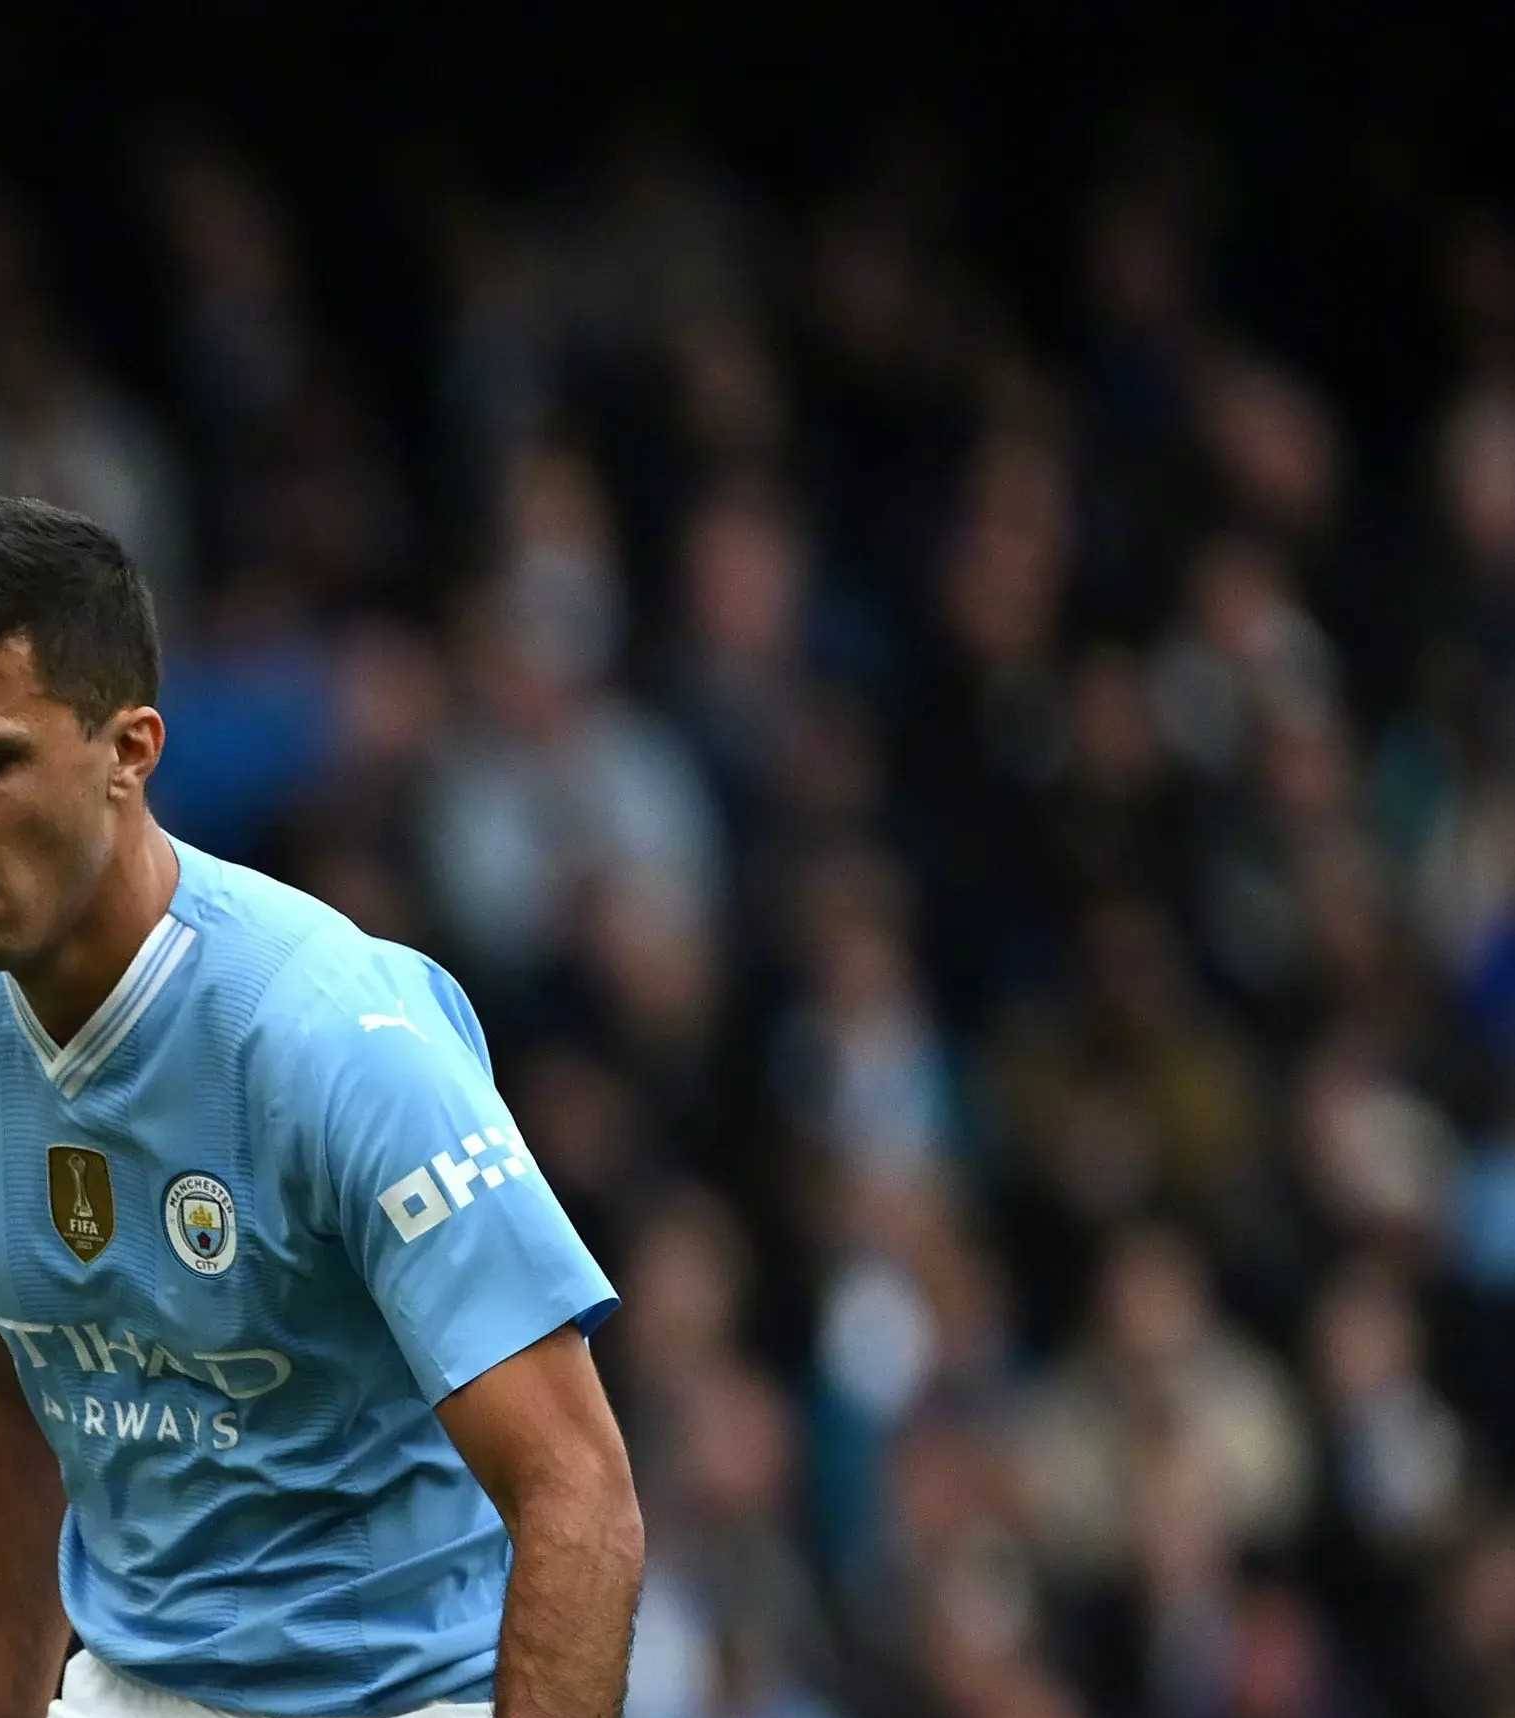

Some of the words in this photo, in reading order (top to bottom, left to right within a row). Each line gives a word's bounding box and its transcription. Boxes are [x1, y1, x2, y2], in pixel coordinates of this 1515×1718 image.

[169, 1178, 234, 1214] MANCHESTER
[69, 1218, 99, 1236] FIFA
[194, 1259, 219, 1271] CITY
